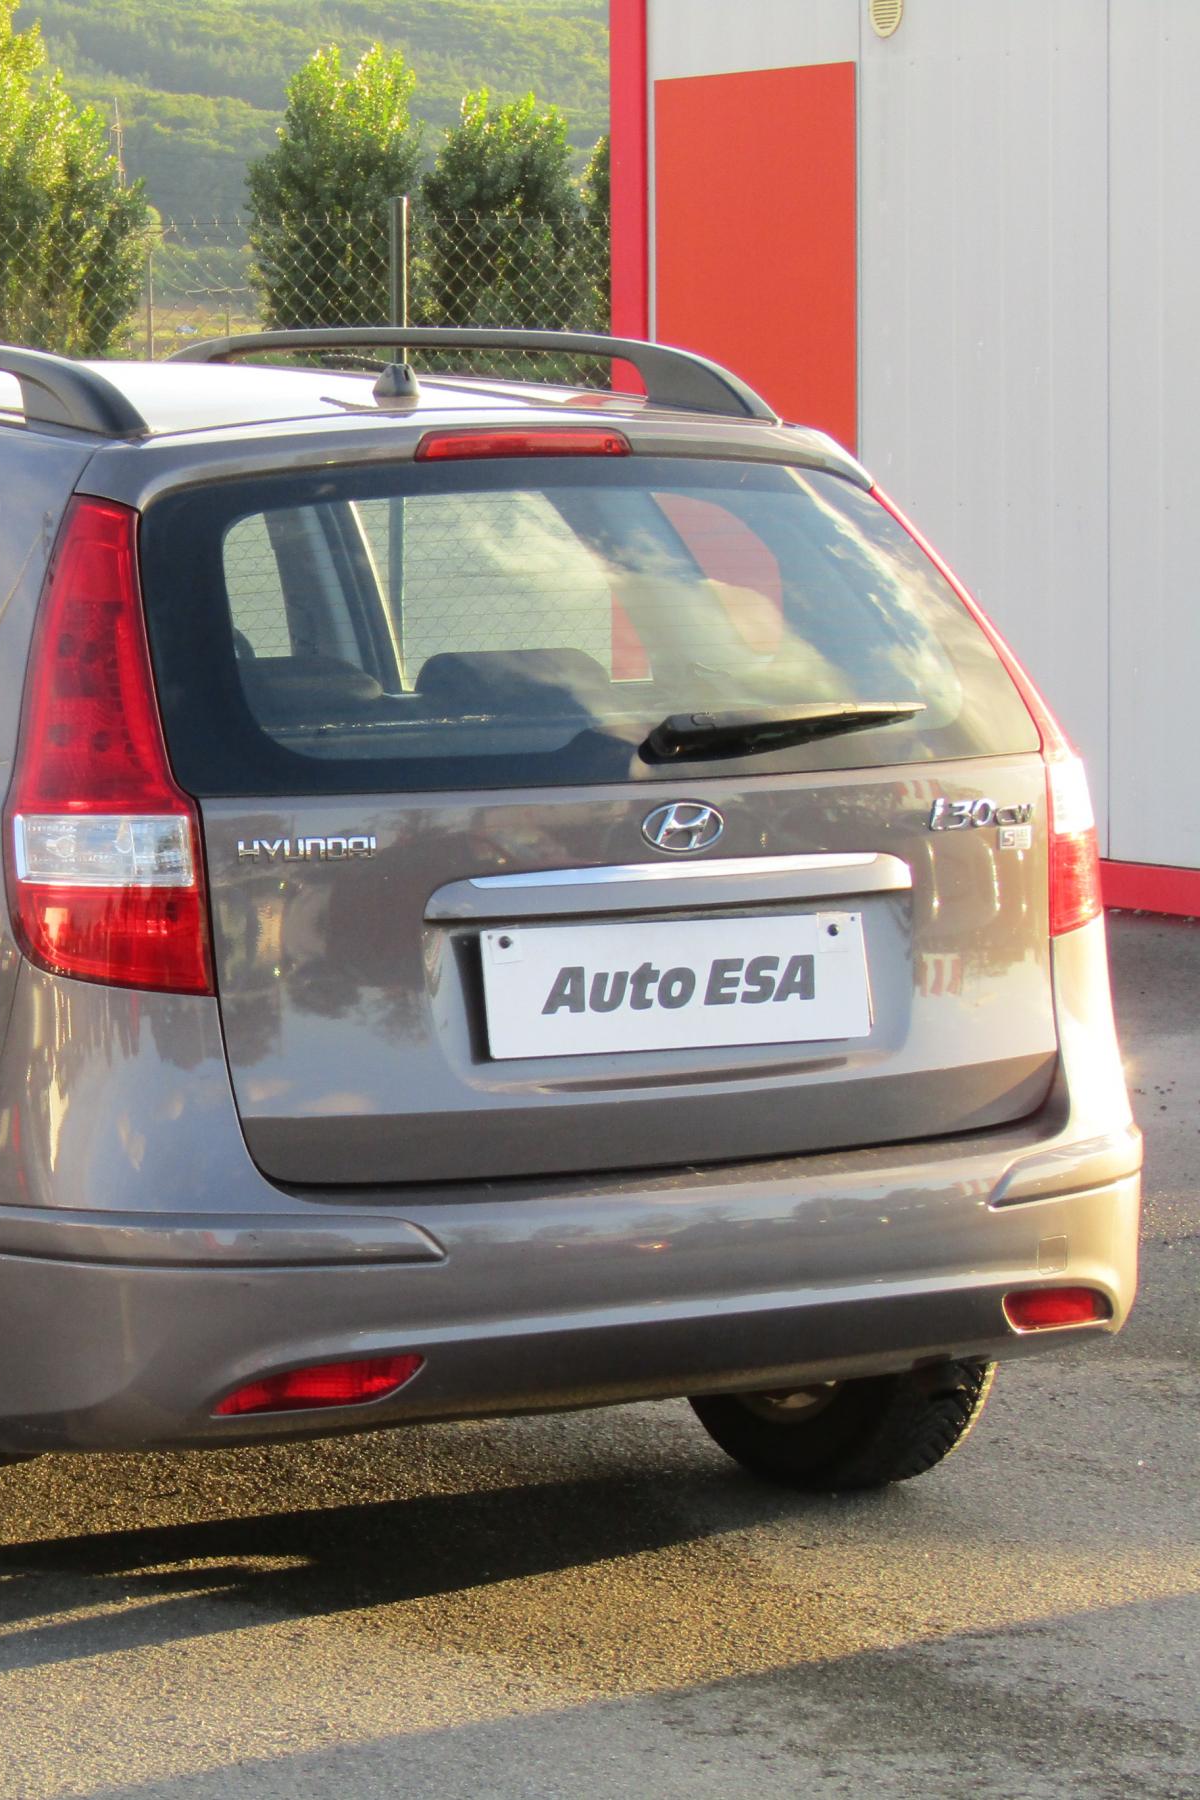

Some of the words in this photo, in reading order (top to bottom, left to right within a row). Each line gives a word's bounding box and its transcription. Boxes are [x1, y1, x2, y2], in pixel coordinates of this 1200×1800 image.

[237, 836, 377, 861] HYUNDAI
[541, 962, 696, 1015] Auto
[704, 954, 815, 1006] ESA
